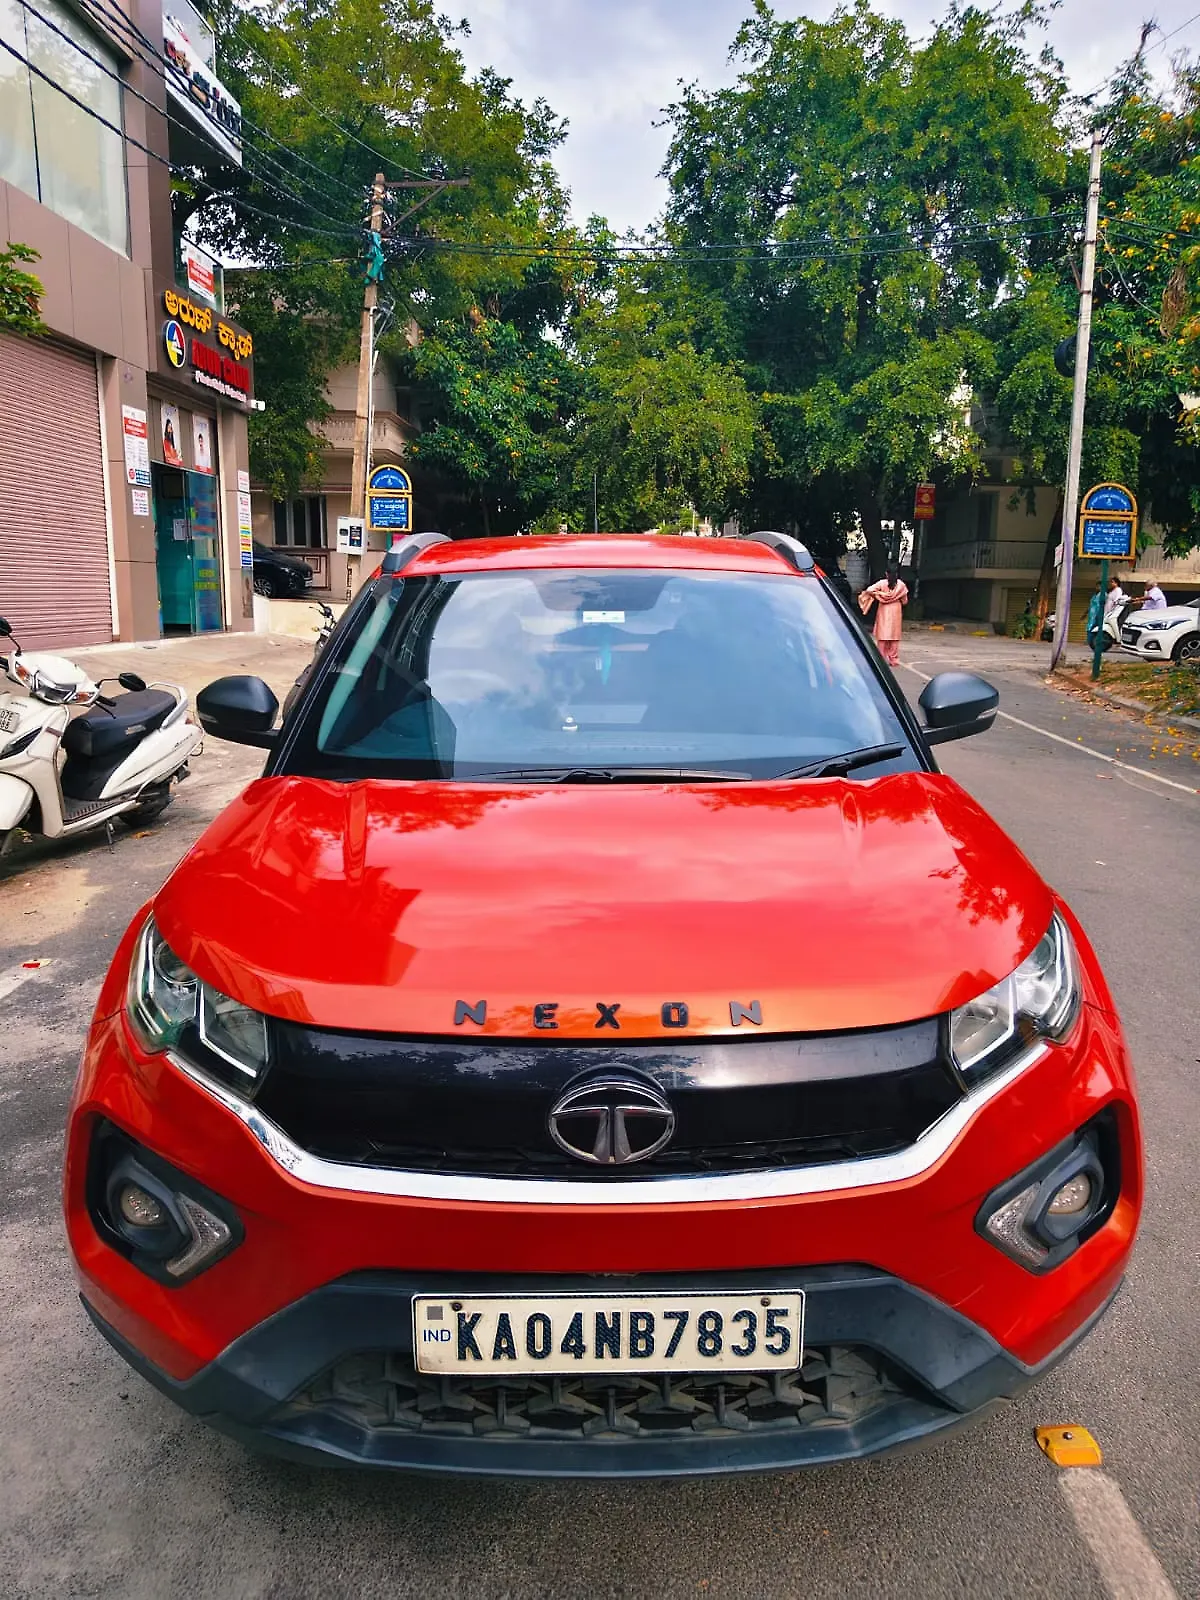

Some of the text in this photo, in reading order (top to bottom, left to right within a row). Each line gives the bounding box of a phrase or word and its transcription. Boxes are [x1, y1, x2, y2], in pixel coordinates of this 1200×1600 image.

[454, 1000, 763, 1029] NEXON
[423, 1308, 791, 1361] IND KA04NB7835
